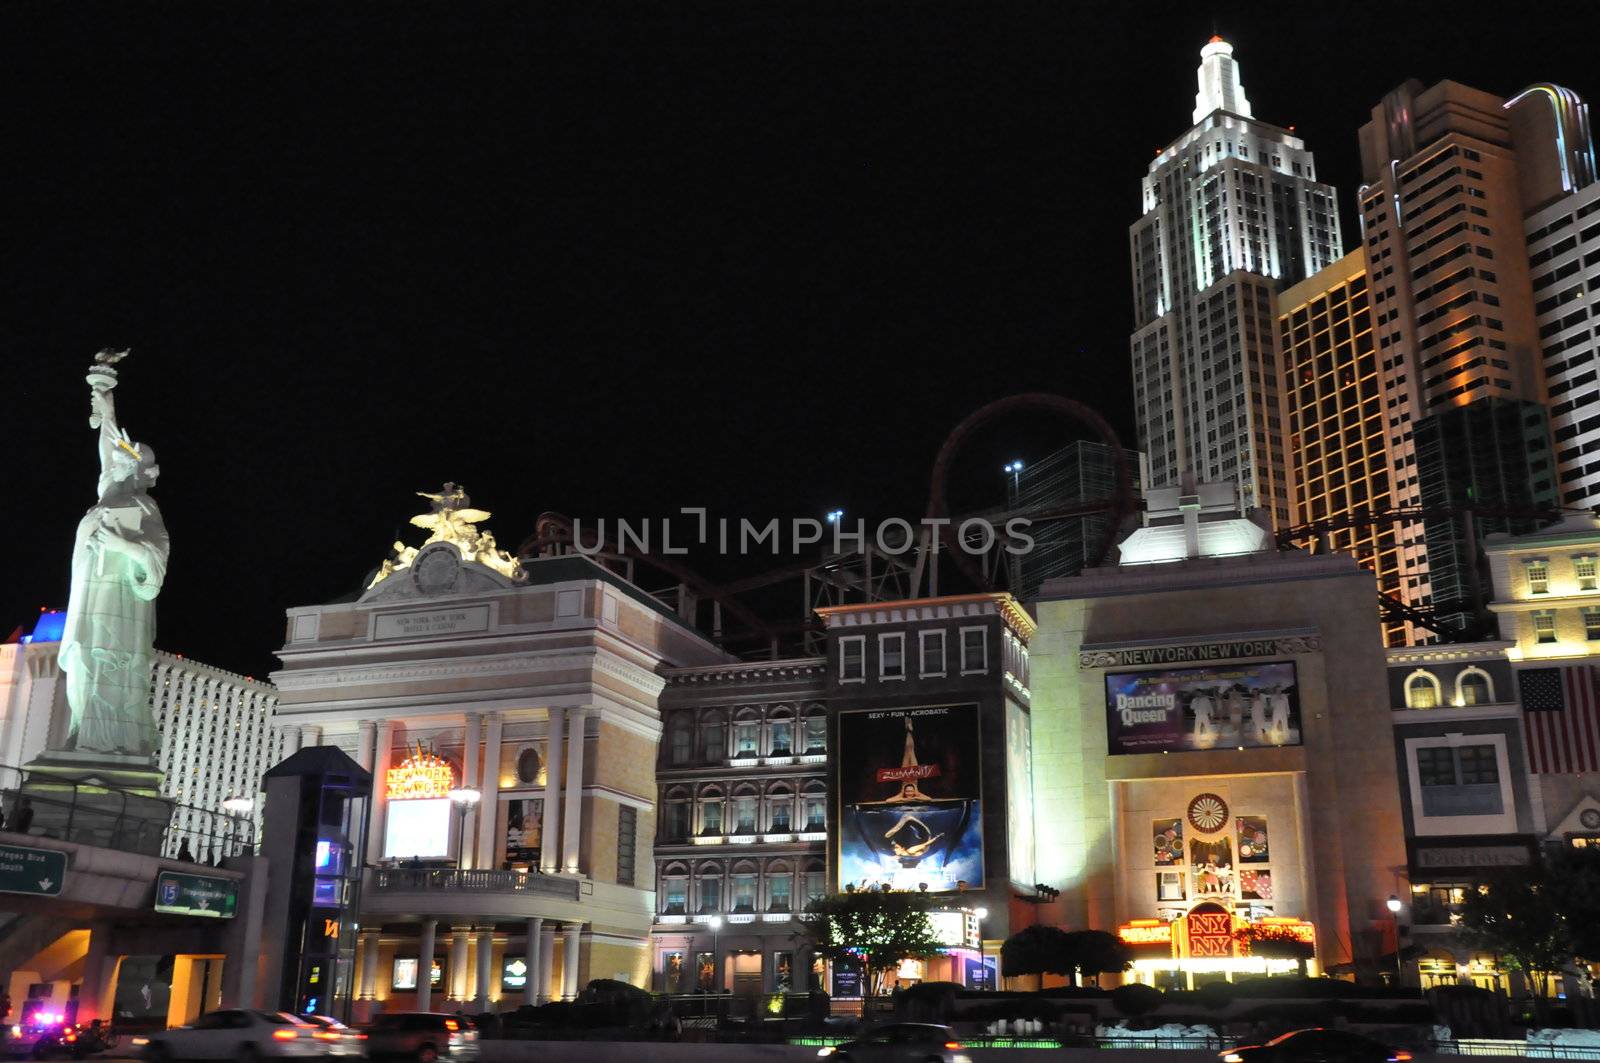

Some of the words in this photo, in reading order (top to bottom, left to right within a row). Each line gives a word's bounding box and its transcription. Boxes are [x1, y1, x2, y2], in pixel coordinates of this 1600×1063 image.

[1123, 650, 1155, 665] NEW
[1156, 647, 1197, 663] YORK
[1199, 645, 1232, 661] NEW
[1233, 641, 1274, 657] YORK
[1116, 692, 1176, 711] Dancing
[910, 708, 949, 717] ACROBATIC
[1121, 710, 1167, 726] Queen
[881, 764, 934, 780] ZUMANITY
[164, 886, 176, 900] 15
[1189, 913, 1230, 935] NY
[1191, 935, 1231, 956] NY
